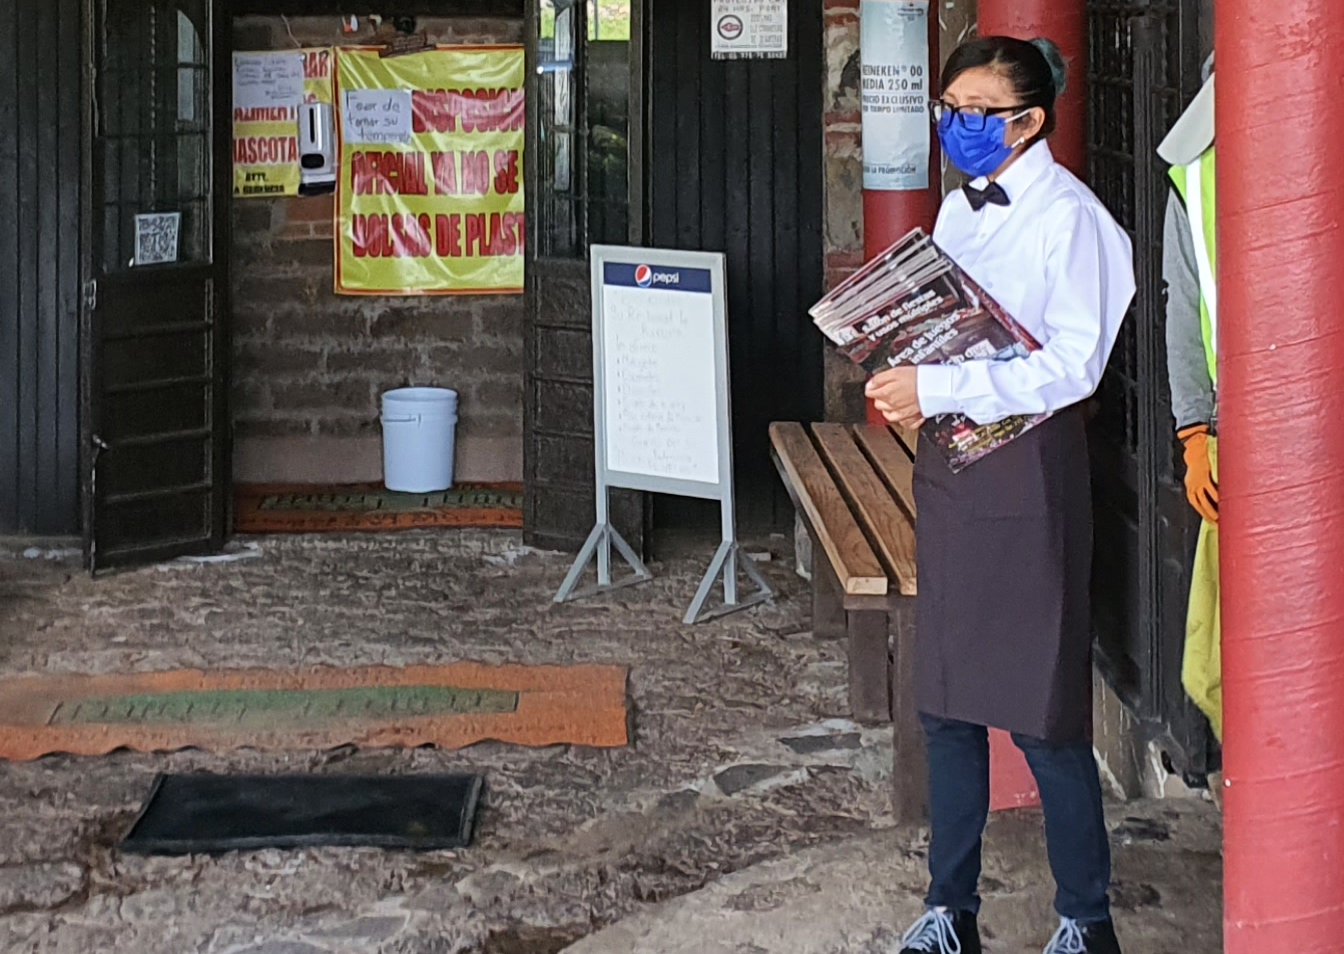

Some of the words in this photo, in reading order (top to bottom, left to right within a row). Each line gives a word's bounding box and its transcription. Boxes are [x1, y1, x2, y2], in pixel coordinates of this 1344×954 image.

[887, 78, 908, 91] 250
[911, 77, 923, 91] ml
[352, 150, 428, 196] OFICIAL
[431, 150, 457, 196] YA
[461, 150, 489, 196] NO
[493, 149, 519, 195] SE
[352, 212, 431, 258] BOLSAS
[435, 212, 462, 258] DE
[652, 272, 680, 285] pepsi
